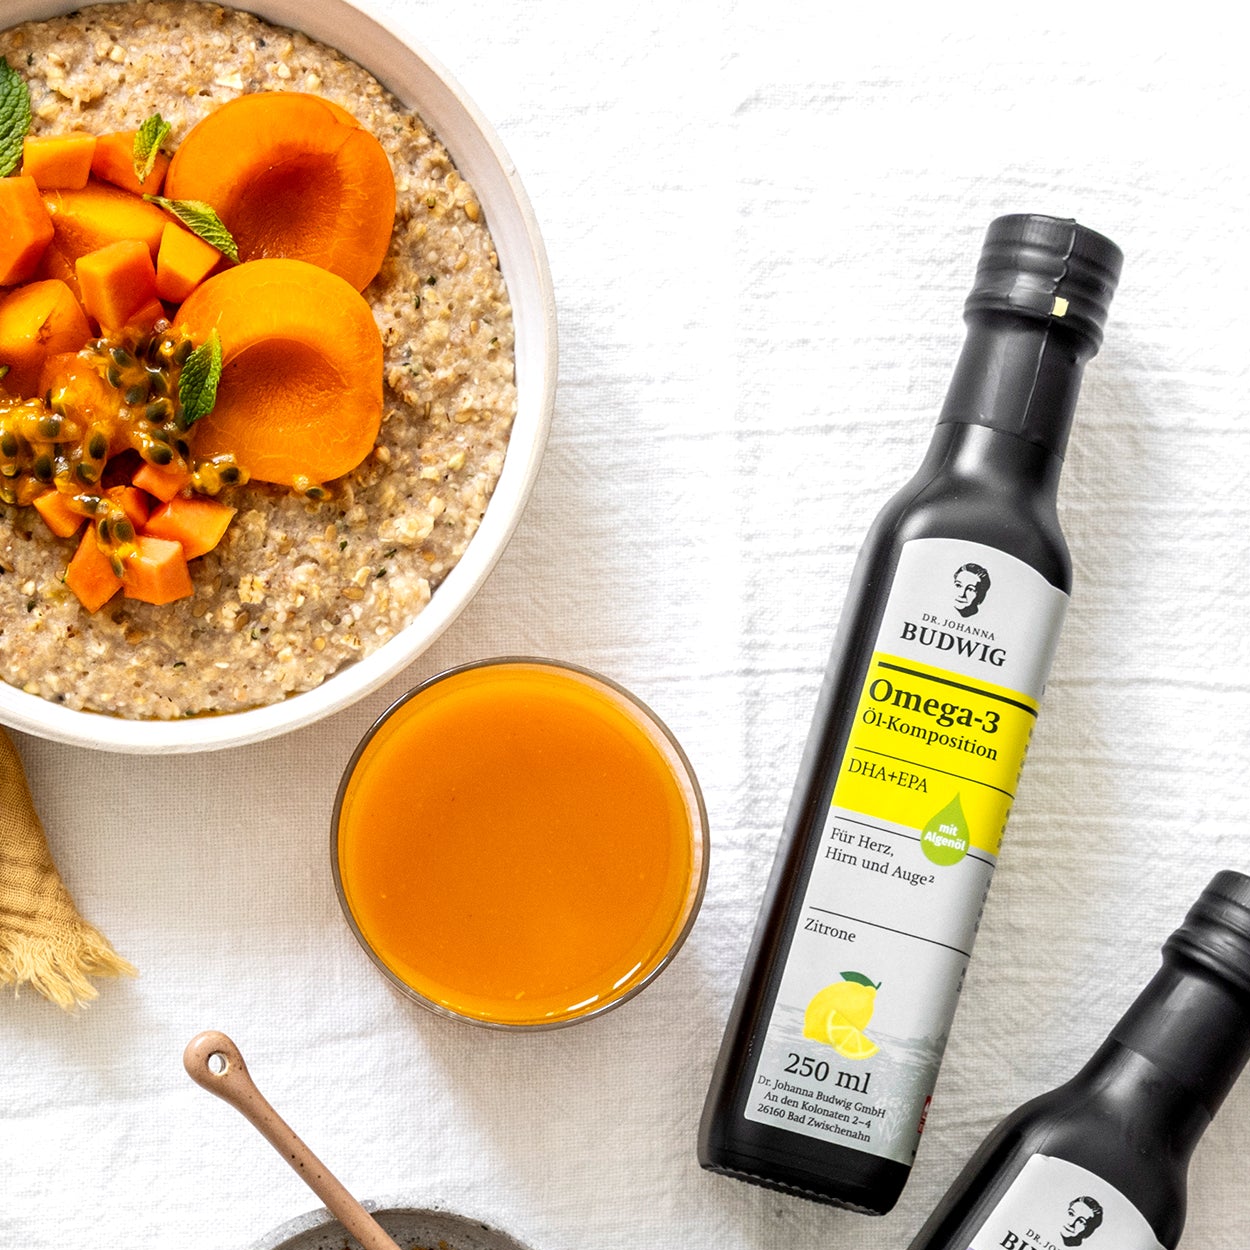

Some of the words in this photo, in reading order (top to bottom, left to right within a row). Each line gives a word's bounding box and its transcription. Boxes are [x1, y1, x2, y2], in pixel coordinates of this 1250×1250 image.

[922, 613, 940, 625] DR.
[942, 618, 995, 641] JOHANNA
[900, 622, 1007, 667] BUDWIG
[869, 679, 1000, 734] Omega-3
[863, 707, 997, 760] Öl-Komposition
[848, 758, 928, 793] DHA+EPA
[830, 828, 855, 844] Für
[858, 835, 894, 857] Herz,
[924, 832, 966, 850] Algenöl
[939, 823, 958, 836] mit
[825, 847, 857, 866] Hirn
[862, 859, 888, 874] und
[804, 918, 856, 942] Zitrone
[784, 1053, 829, 1082] 250
[835, 1070, 871, 1094] ml
[757, 1076, 771, 1086] Dr.
[772, 1079, 814, 1098] Johanna
[817, 1092, 853, 1111] Budwig
[854, 1102, 886, 1118] GmbH
[764, 1092, 778, 1103] An
[780, 1096, 799, 1109] den
[801, 1101, 849, 1123] Kolonaten
[757, 1104, 785, 1118] 26160
[787, 1111, 806, 1124] Bad
[807, 1117, 871, 1142] Zwischenahn
[1026, 1229, 1042, 1245] DR.
